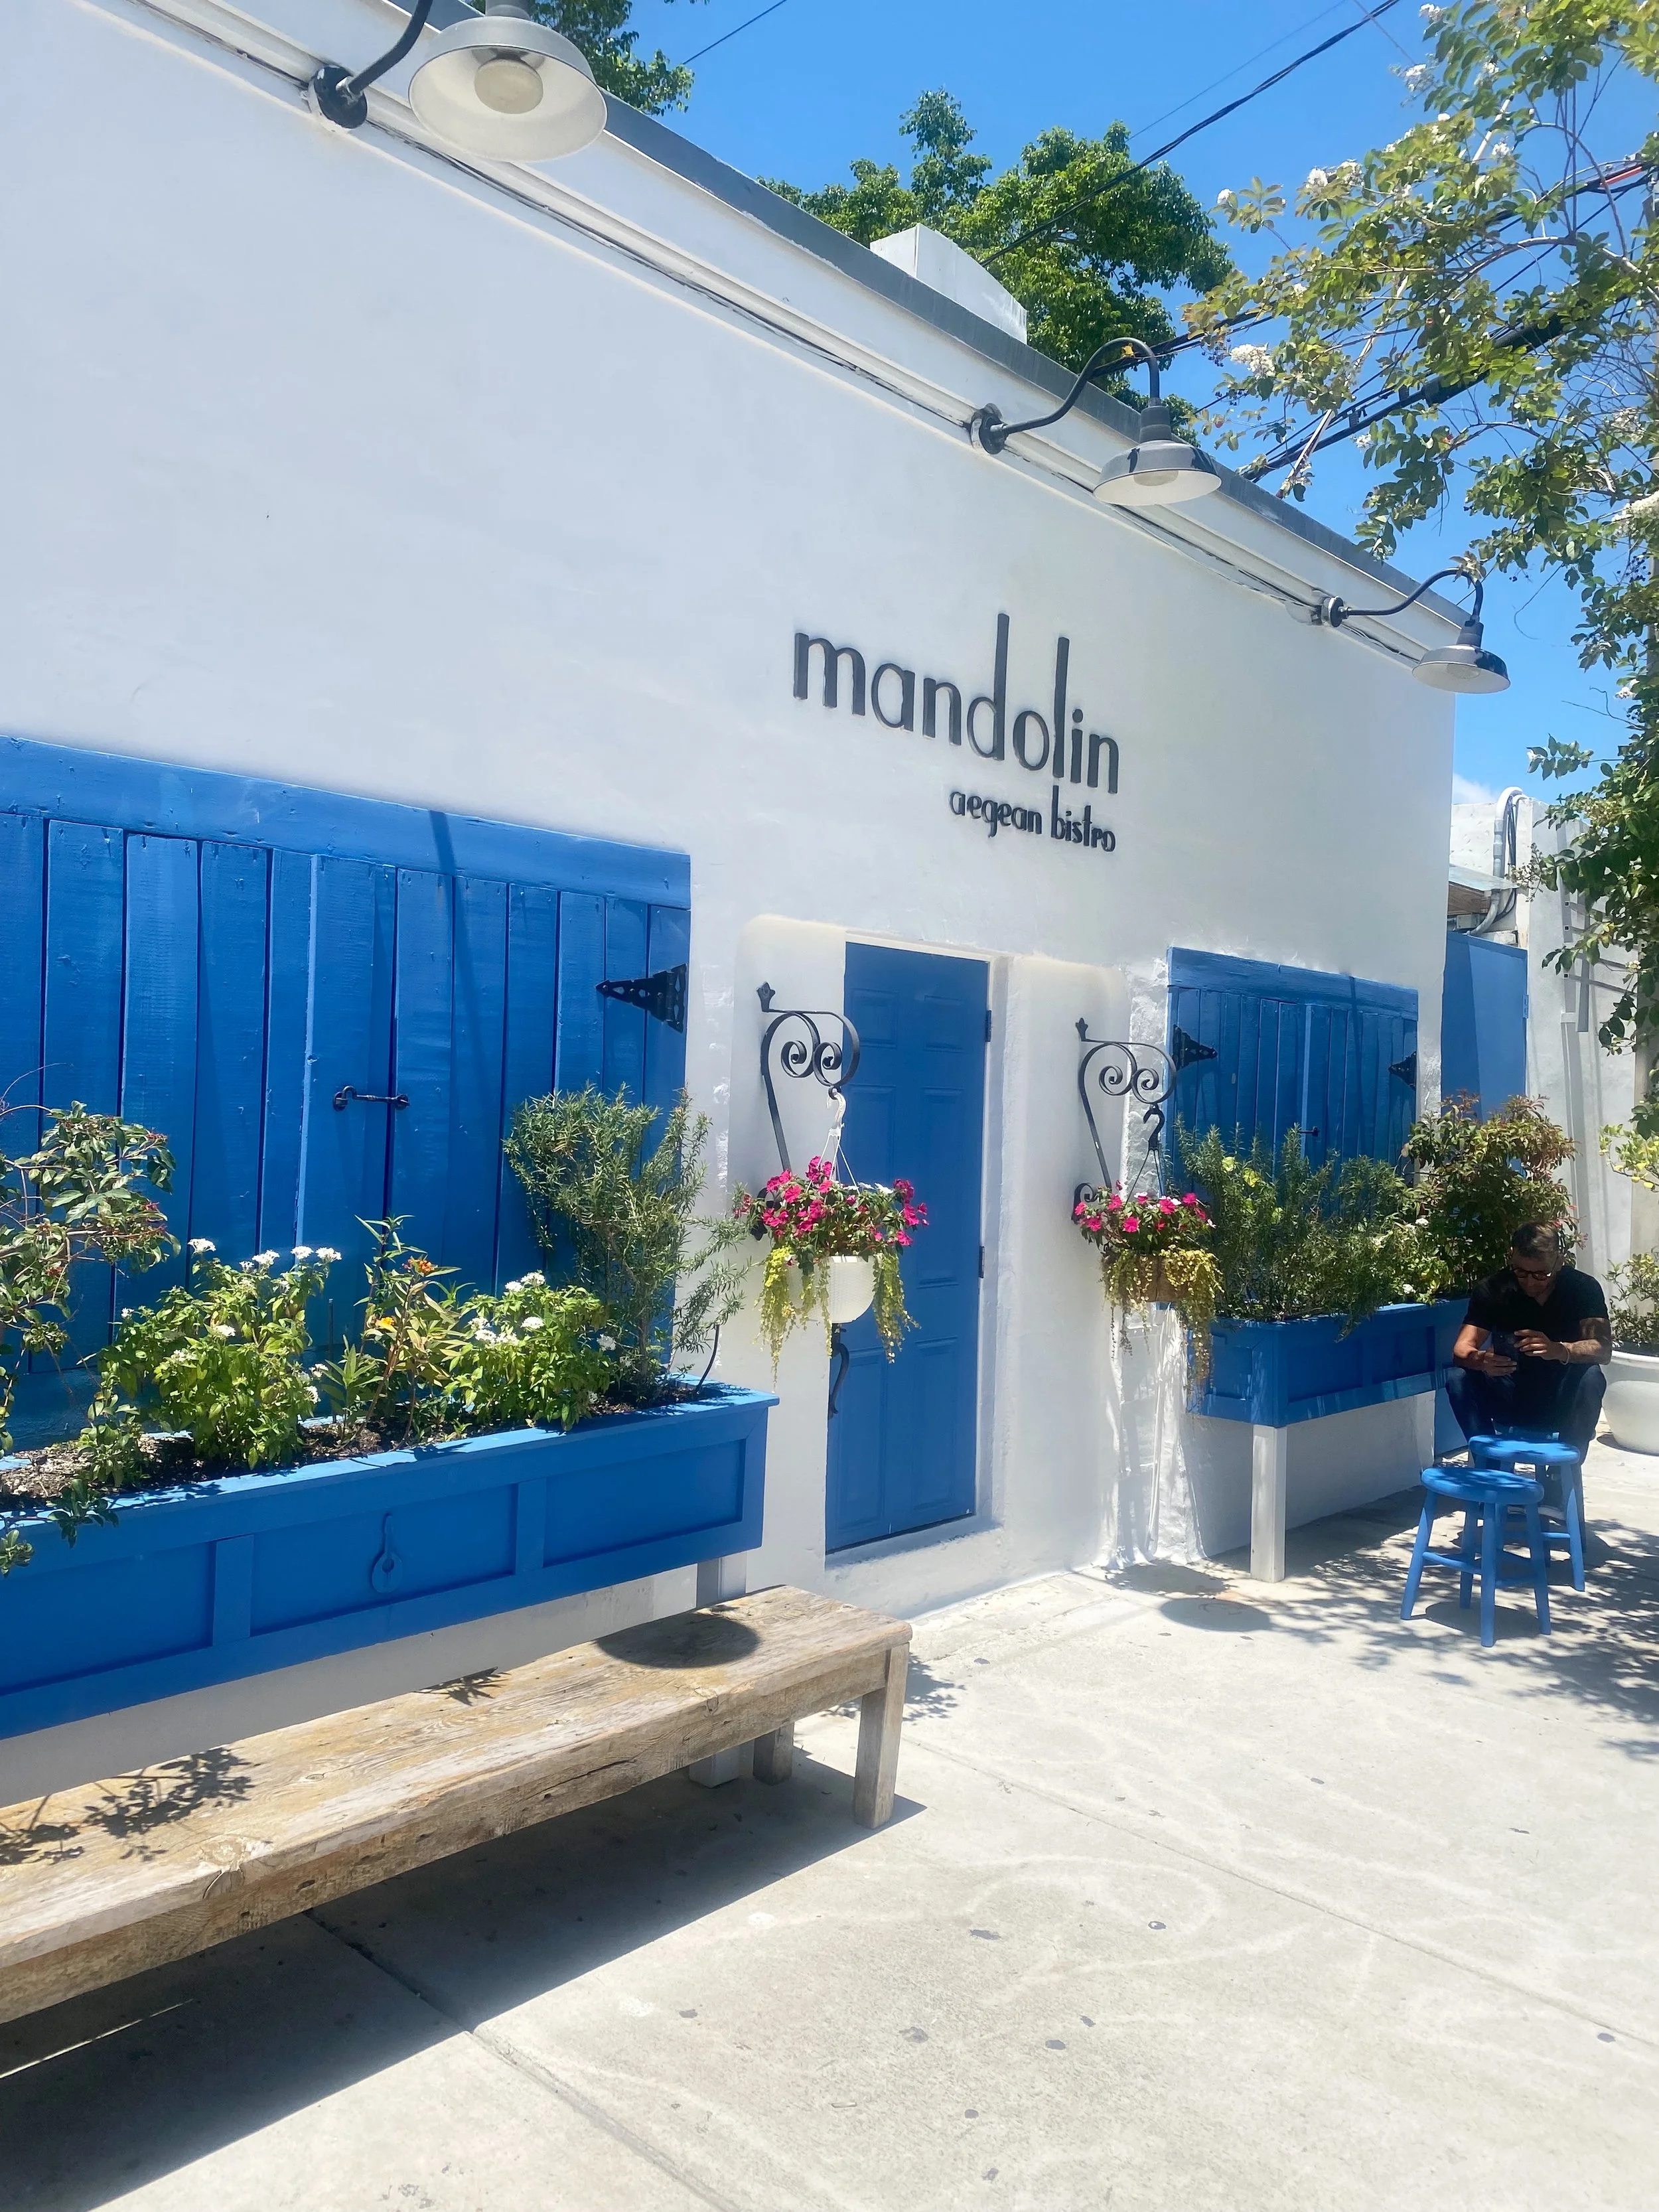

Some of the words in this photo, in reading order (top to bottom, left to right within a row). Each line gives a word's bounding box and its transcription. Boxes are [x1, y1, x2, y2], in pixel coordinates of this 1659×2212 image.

[793, 613, 1119, 794] mandolin
[949, 791, 1043, 838] aegean
[1050, 784, 1116, 852] bistro
